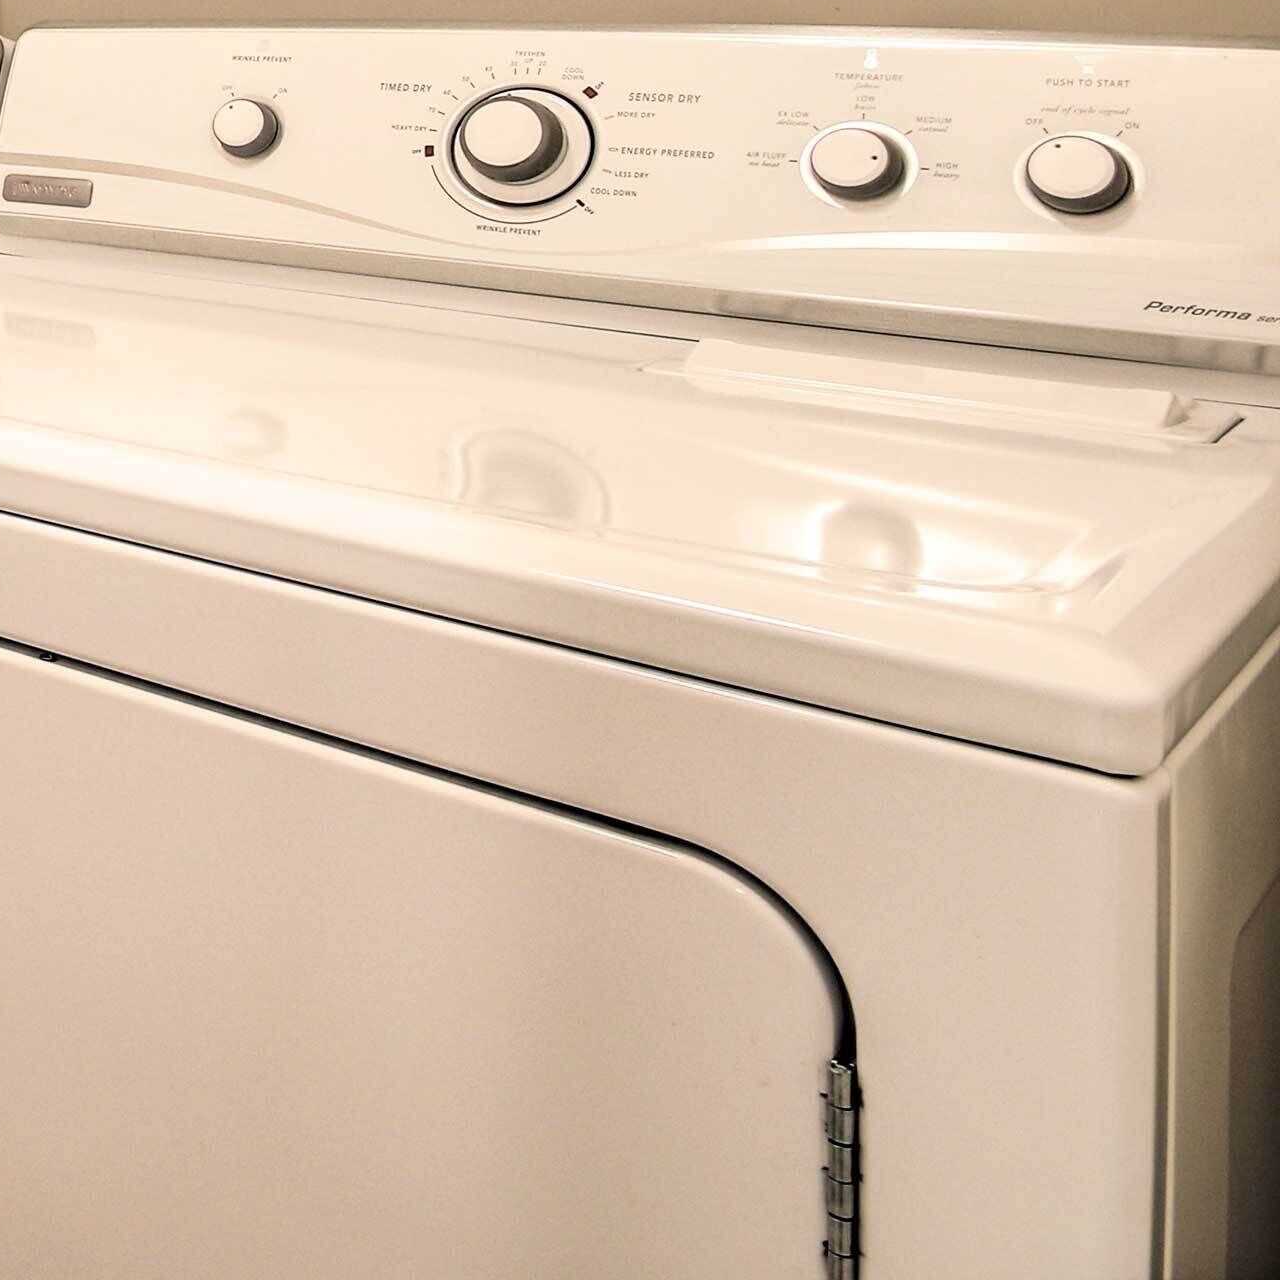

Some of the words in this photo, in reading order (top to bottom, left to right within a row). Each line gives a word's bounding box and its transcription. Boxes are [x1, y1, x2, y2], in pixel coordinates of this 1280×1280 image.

[231, 54, 260, 63] WRINKLE
[262, 55, 292, 64] PREVENT
[562, 73, 584, 81] DOWN
[834, 72, 904, 82] TEMPERATURE
[380, 82, 410, 93] TIMED
[413, 84, 432, 93] DRY
[1045, 78, 1074, 87] PUSH
[1079, 79, 1092, 87] TO
[1096, 79, 1130, 88] START
[628, 92, 673, 103] SENSOR
[677, 93, 702, 104] DRY
[617, 111, 638, 119] MORE
[640, 111, 656, 119] DRY
[791, 111, 810, 119] LOW
[916, 116, 952, 124] MEDIUM
[1025, 117, 1043, 126] OFF
[621, 146, 657, 157] ENERGY
[661, 148, 715, 159] PREFERRED
[762, 151, 787, 160] FLUFF
[936, 161, 958, 170] HIGH
[614, 170, 631, 178] LESS
[633, 171, 649, 179] DRY
[590, 187, 611, 195] COOL
[613, 189, 638, 197] DOWN
[476, 224, 507, 234] WRINKLE
[508, 227, 541, 236] PREVENT
[1143, 300, 1252, 321] Performa
